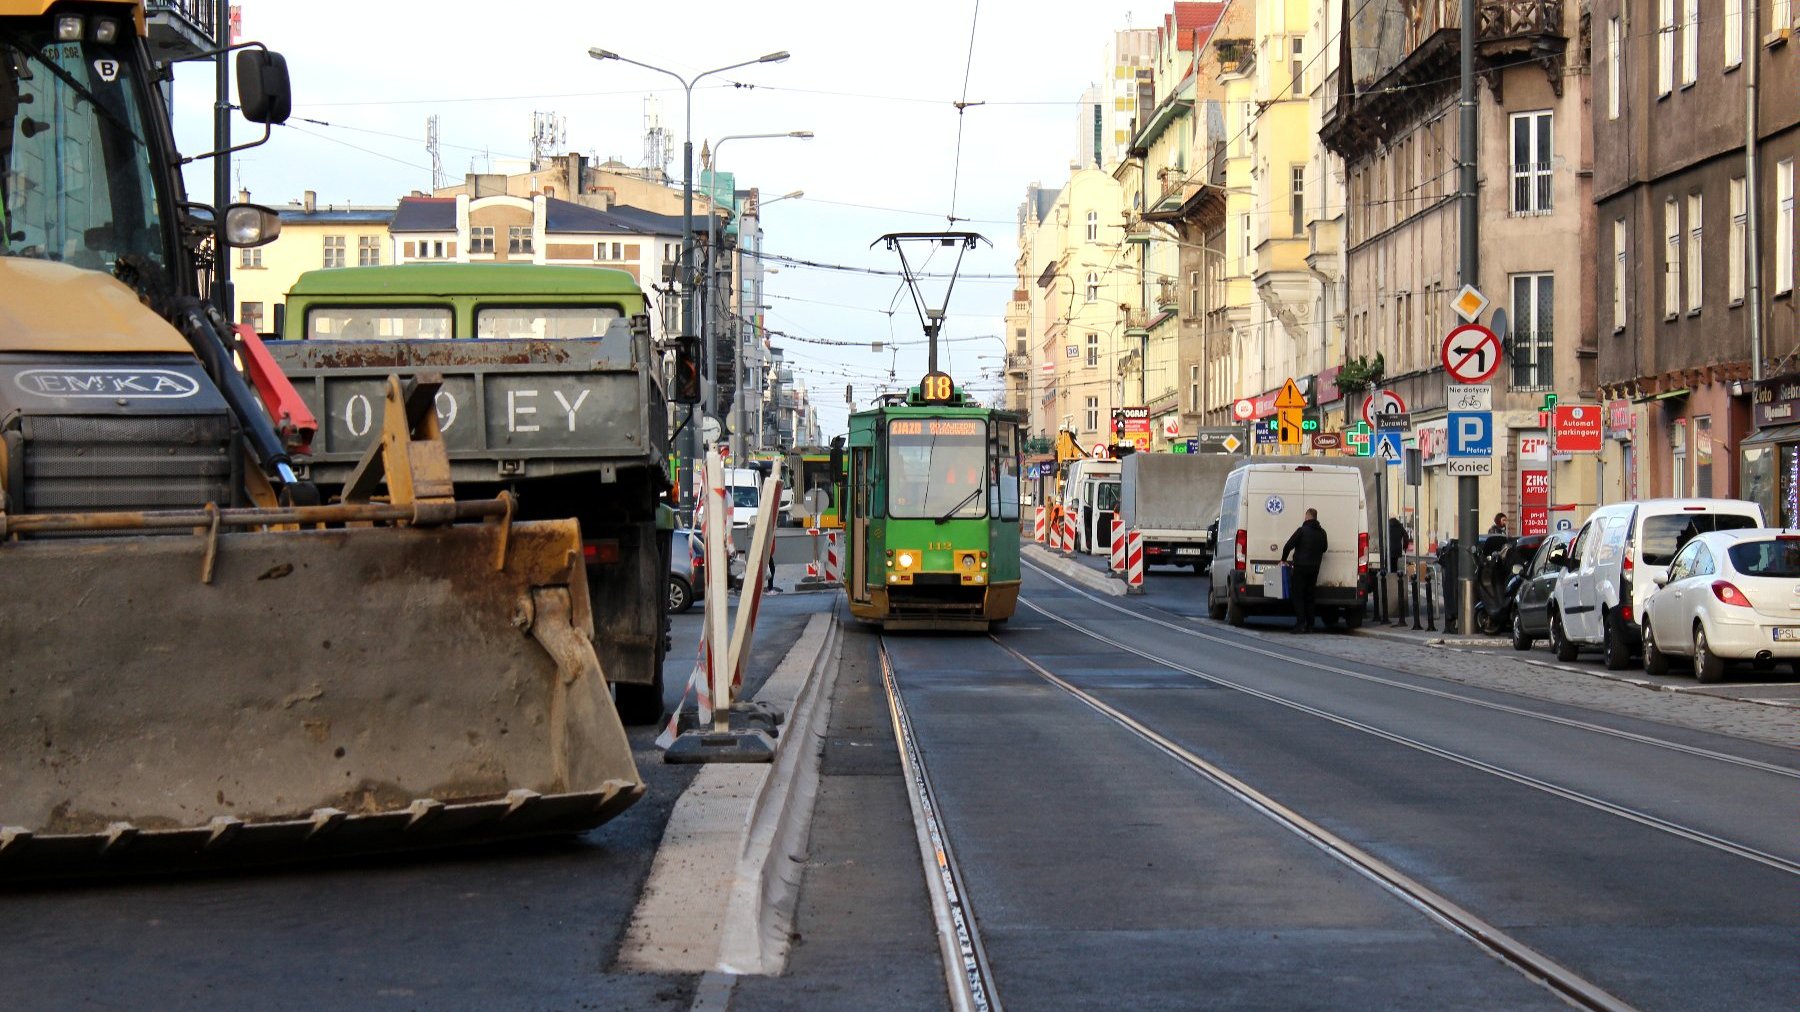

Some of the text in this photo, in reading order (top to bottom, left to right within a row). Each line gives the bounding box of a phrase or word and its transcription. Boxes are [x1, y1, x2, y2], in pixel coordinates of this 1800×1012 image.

[101, 61, 115, 77] B
[924, 375, 951, 400] 18
[1112, 409, 1148, 418] FOGRAF
[1557, 429, 1599, 437] parkingowy
[1466, 446, 1487, 455] Płatny
[1449, 461, 1489, 472] Koniec
